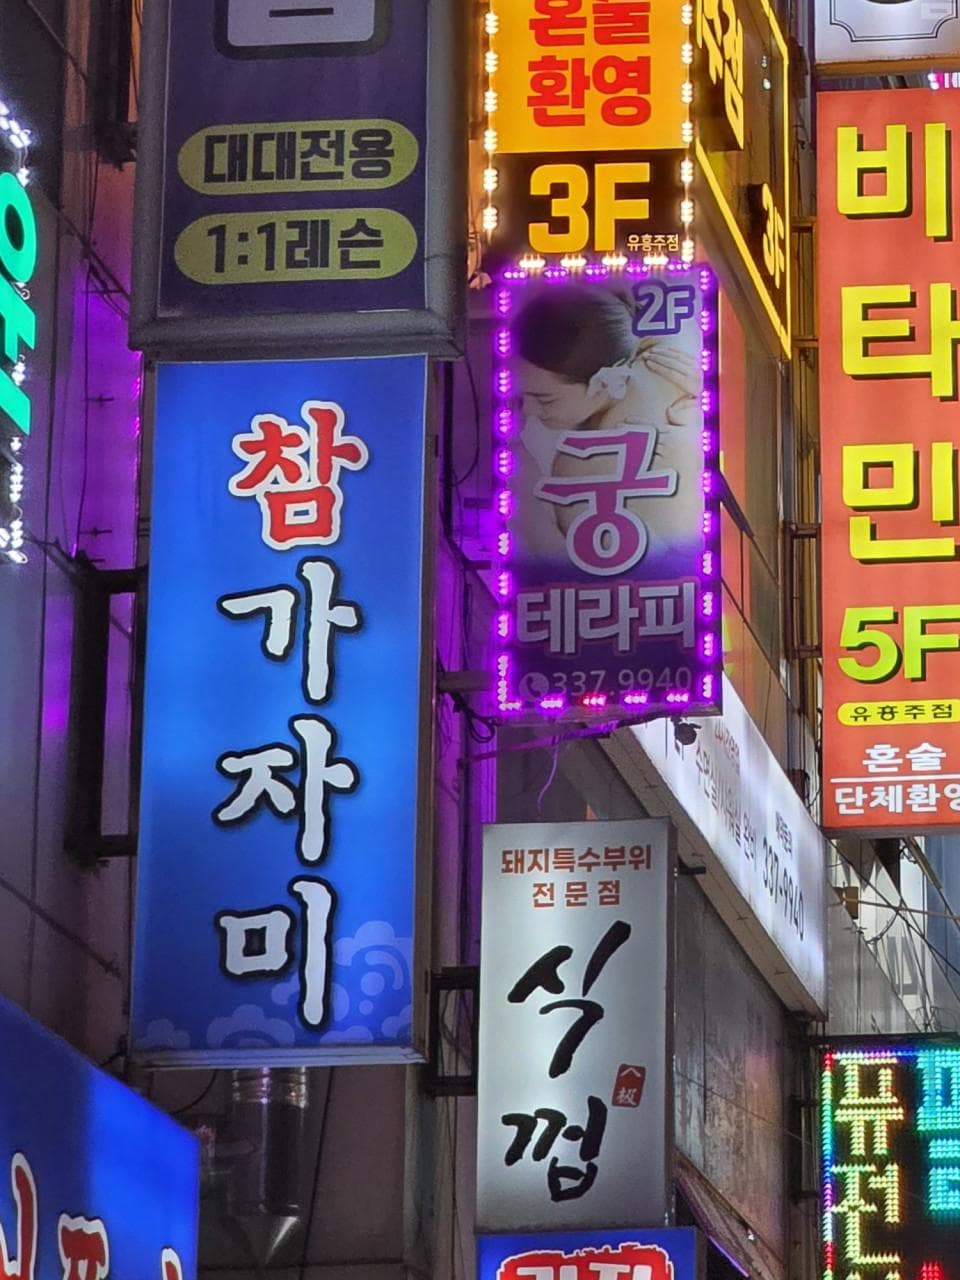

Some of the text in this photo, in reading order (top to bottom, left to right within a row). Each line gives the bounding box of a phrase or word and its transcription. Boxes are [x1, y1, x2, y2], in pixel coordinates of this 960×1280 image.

[526, 54, 652, 128] 환영
[203, 128, 395, 184] 대대전용
[529, 162, 650, 254] 3F
[207, 218, 385, 273] 1:1레슨
[626, 234, 679, 252] 유흥주점
[635, 287, 694, 332] 2F
[533, 425, 679, 577] 궁
[517, 582, 696, 654] 테라피
[212, 400, 368, 1030] 참가자미
[850, 703, 954, 722] 유흥주점
[862, 742, 947, 774] 혼술
[501, 843, 653, 876] 돼지특수부위
[532, 881, 621, 908] 전문점
[762, 836, 804, 942] 337-9940
